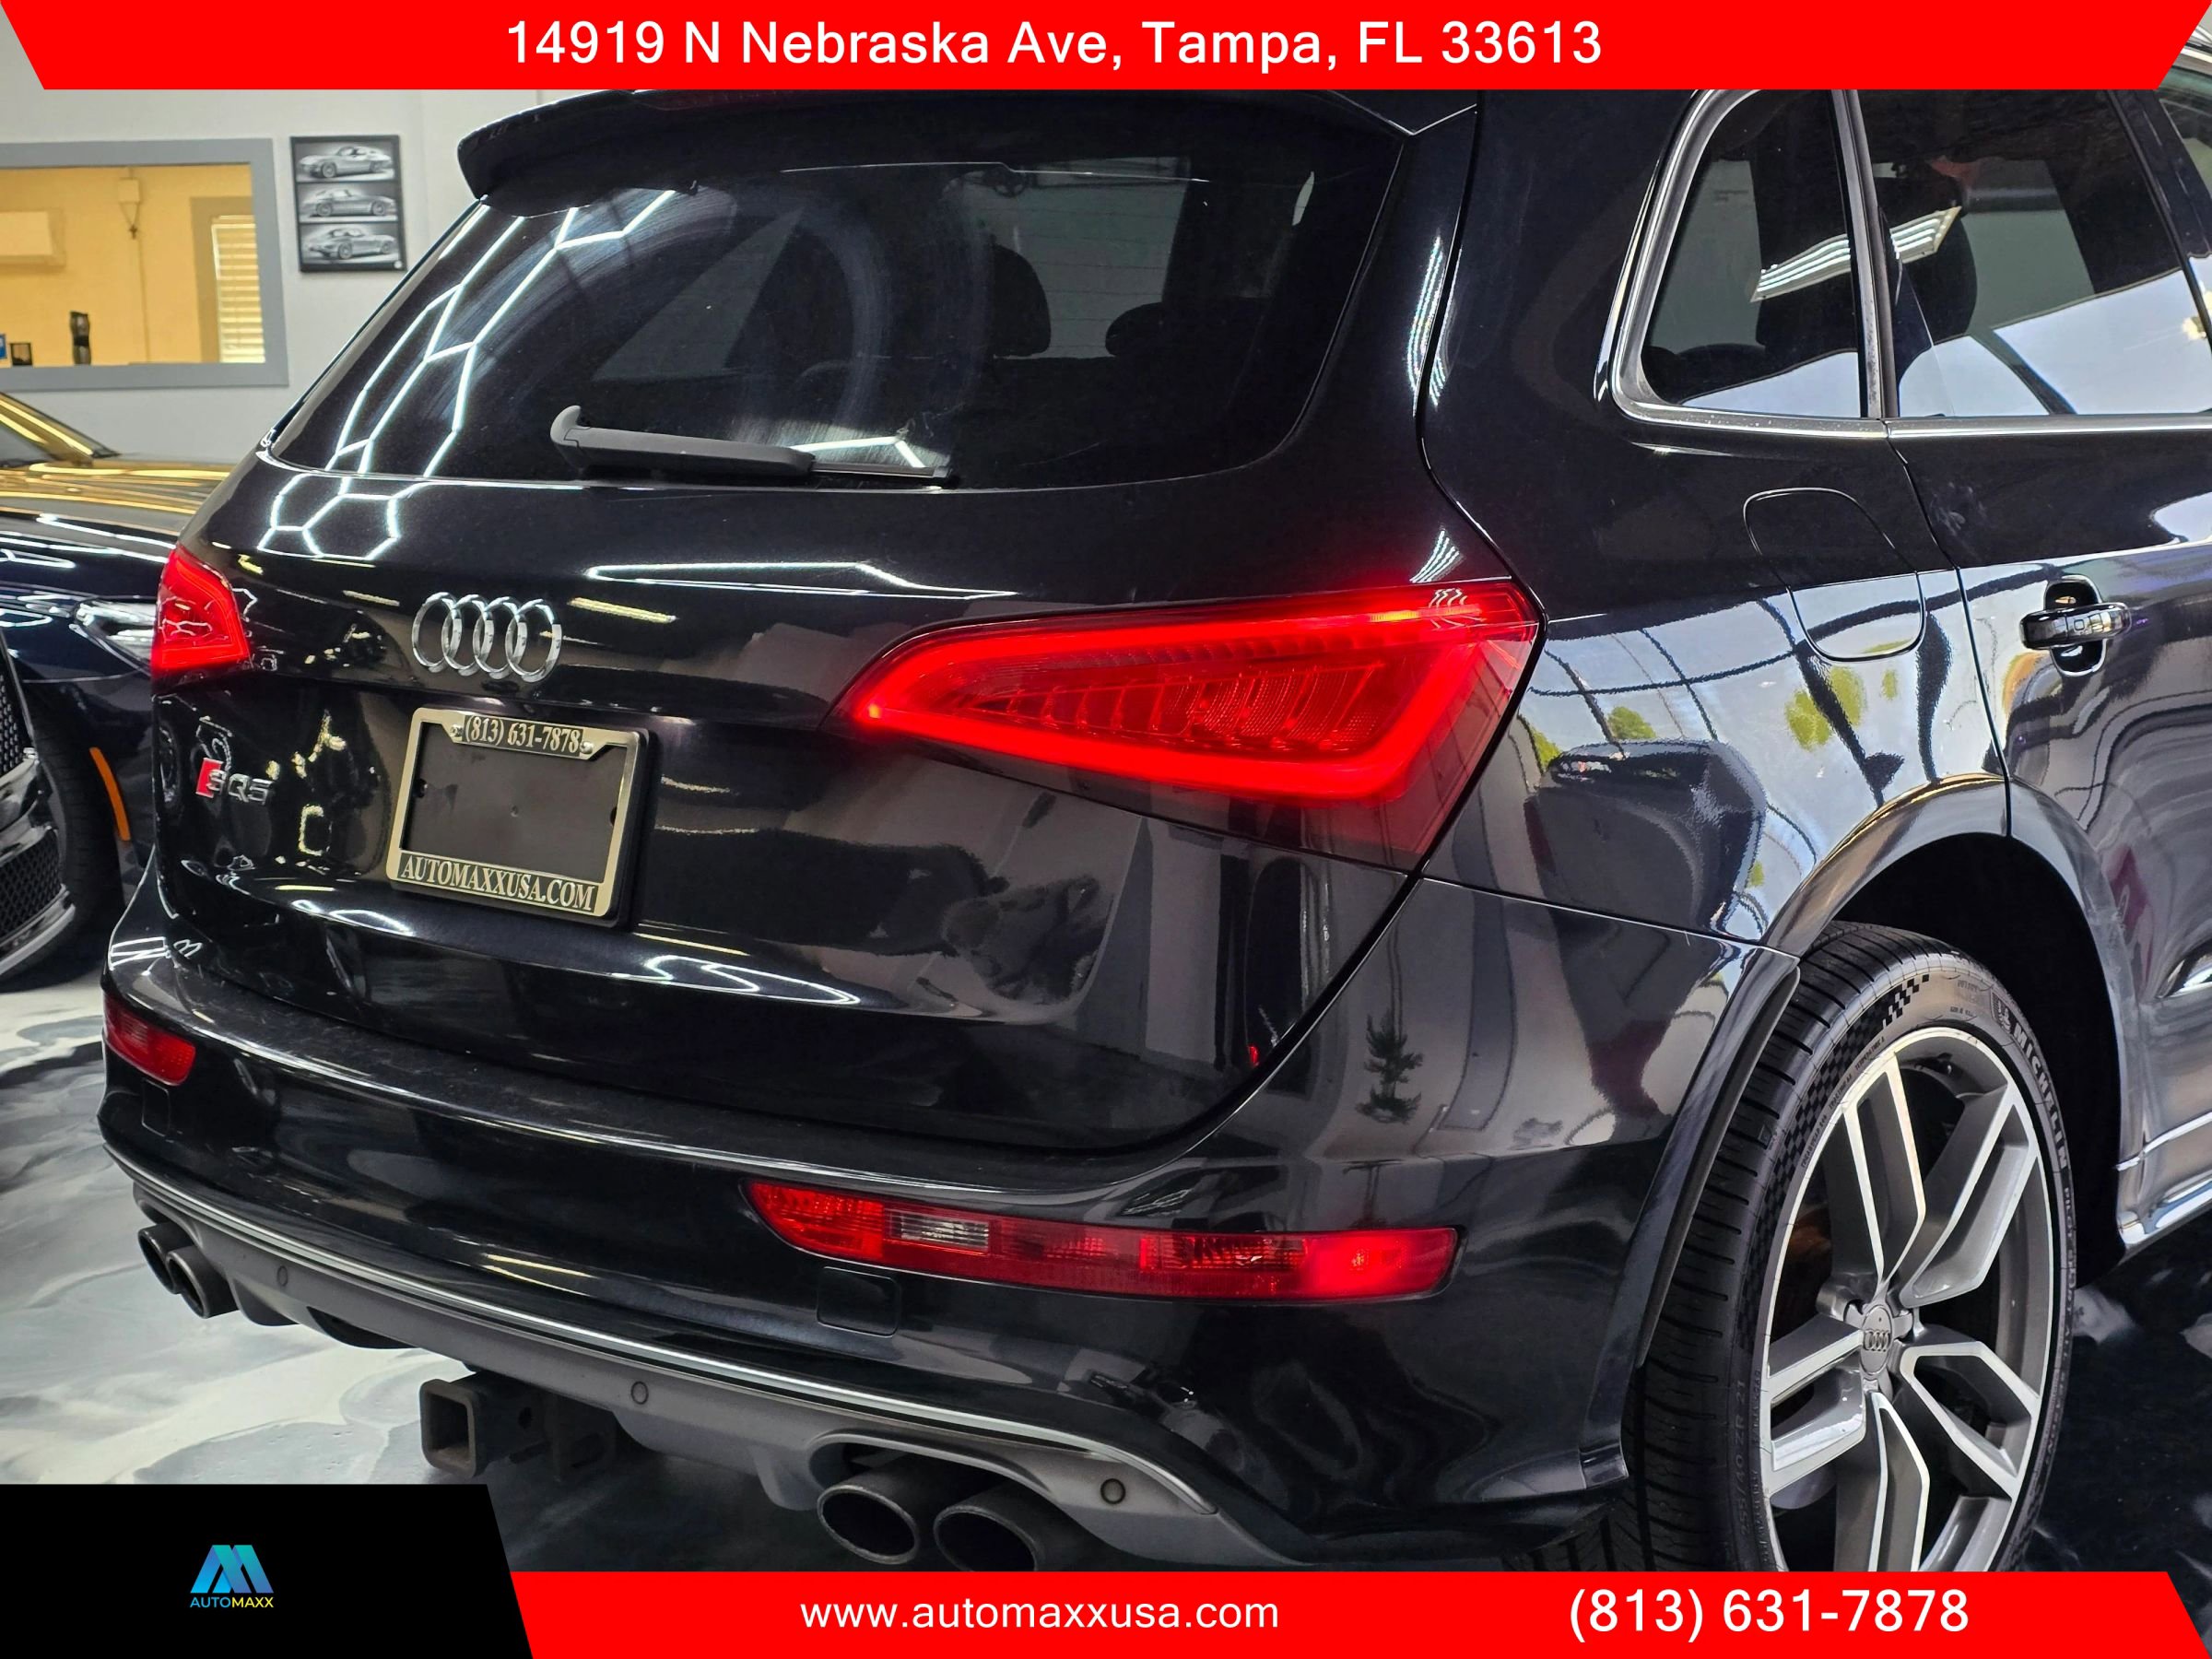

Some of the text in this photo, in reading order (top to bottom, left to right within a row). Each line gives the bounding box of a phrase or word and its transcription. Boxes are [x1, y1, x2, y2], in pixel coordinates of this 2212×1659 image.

[465, 715, 582, 754] (813) 631-7878
[400, 854, 595, 912] AUTOMAXXUSA.COM
[2013, 1022, 2068, 1169] MICHELIN
